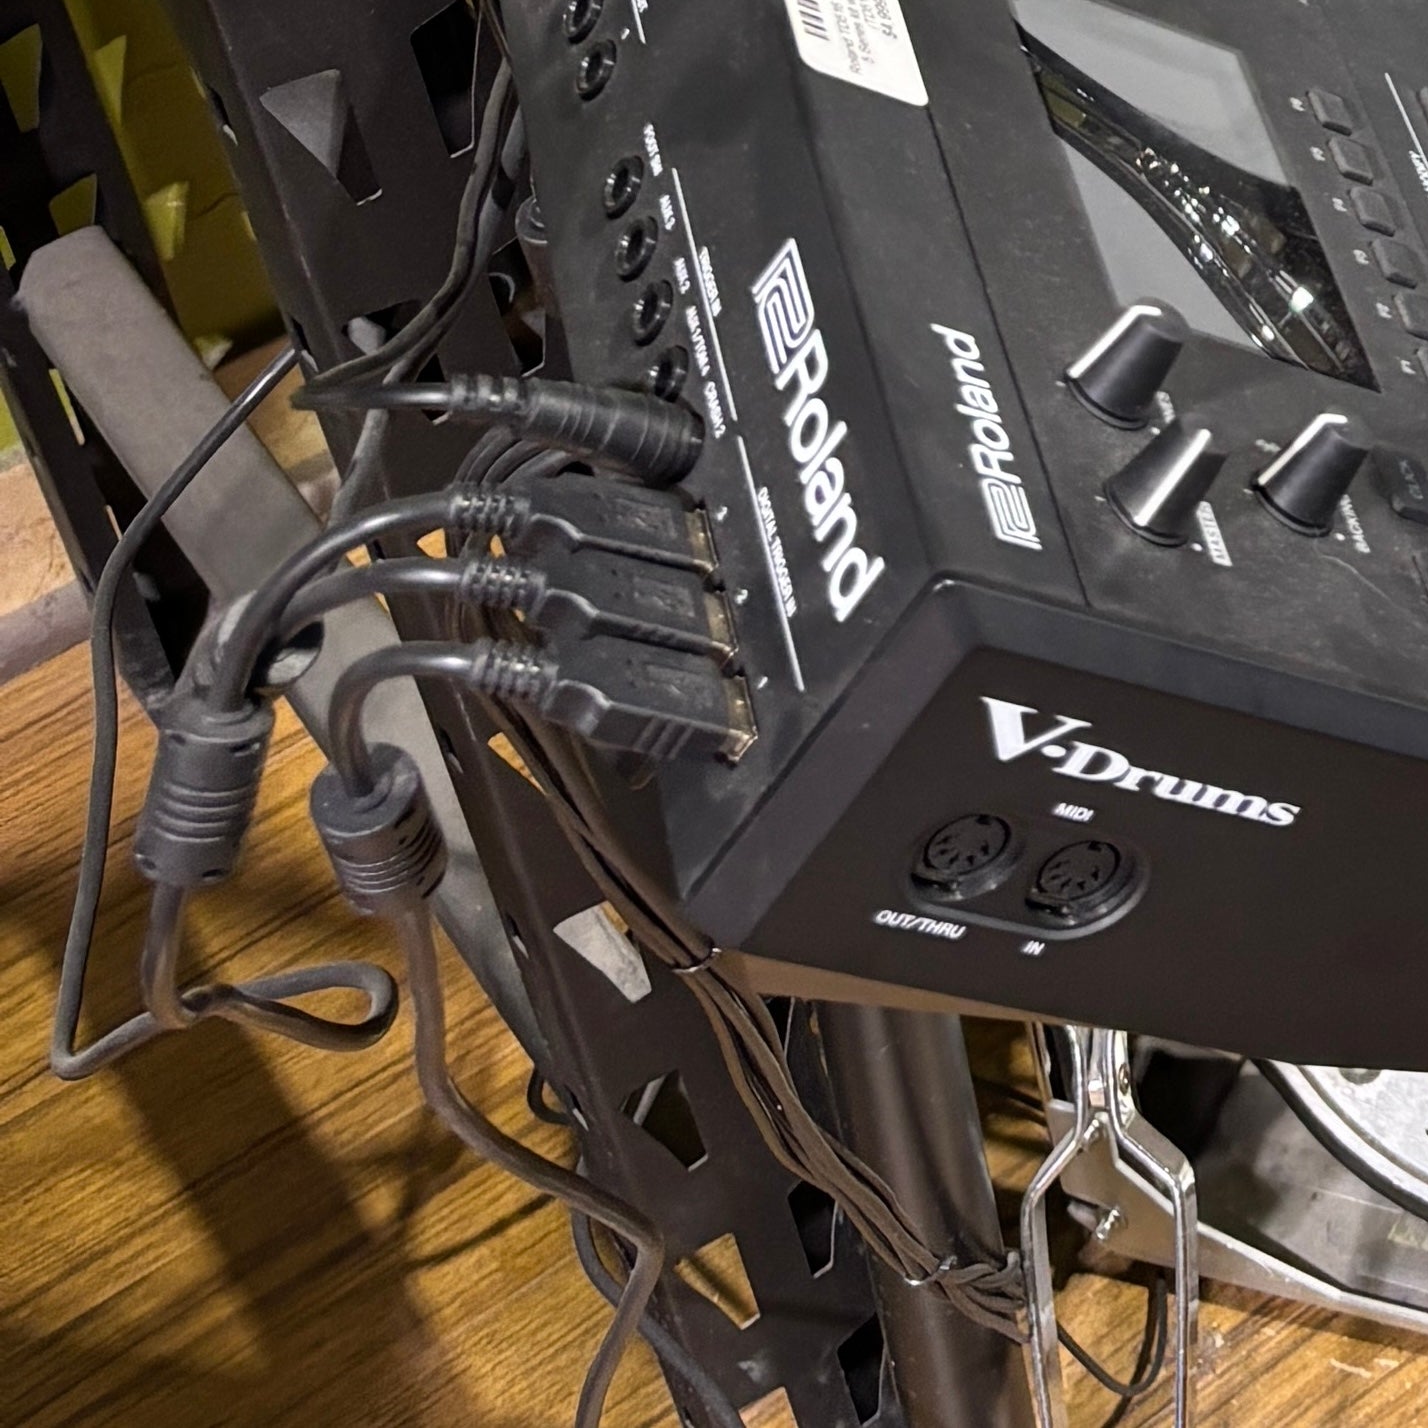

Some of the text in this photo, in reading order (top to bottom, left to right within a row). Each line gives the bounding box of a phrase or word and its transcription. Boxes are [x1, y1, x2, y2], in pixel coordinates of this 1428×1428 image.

[930, 324, 1013, 483] Roland
[774, 327, 885, 622] Roland
[1197, 501, 1232, 567] MASTER
[1052, 801, 1095, 823] MIDI
[873, 909, 968, 940] OUT/THRU
[1020, 940, 1046, 956] IN
